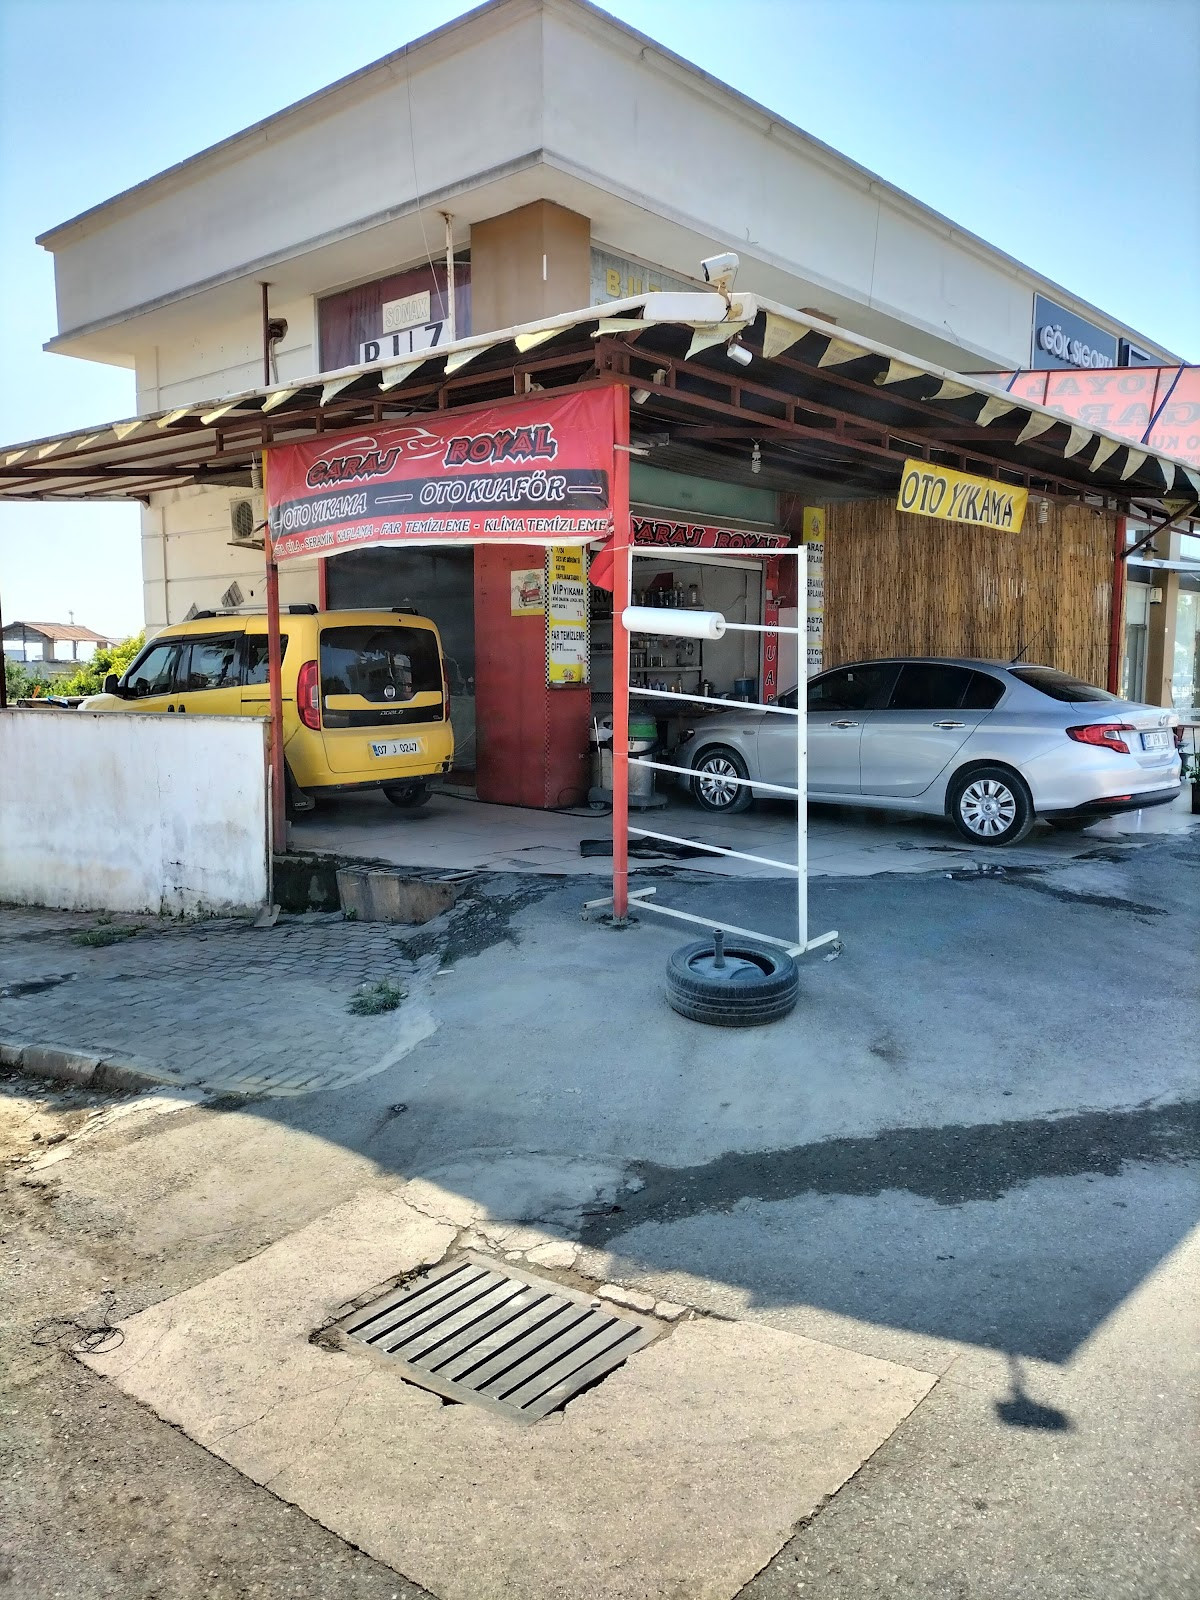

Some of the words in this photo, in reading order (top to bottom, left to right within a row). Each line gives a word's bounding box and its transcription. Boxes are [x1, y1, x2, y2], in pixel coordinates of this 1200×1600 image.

[385, 297, 428, 328] SONAX
[1041, 324, 1071, 359] GÖK
[442, 423, 558, 468] ROYAL
[283, 503, 312, 530] OTO
[311, 492, 368, 524] YIKAMA
[420, 480, 466, 505] OTO
[466, 470, 566, 503] KUAFÖR
[901, 471, 947, 514] OTO
[946, 482, 1014, 528] YIKAMA
[304, 530, 335, 550] SERAMİK
[336, 523, 374, 543] KAPLAMA
[380, 521, 402, 535] FAR
[405, 517, 470, 534] TEMİZLEME
[484, 515, 525, 533] KLİMA
[527, 515, 608, 533] TEMİZLEME
[634, 518, 706, 547] ARAJ
[807, 577, 824, 588] ERAMİK
[807, 588, 824, 598] APLAMA
[807, 616, 823, 625] ASTA
[378, 745, 387, 755] 07
[400, 742, 417, 753] 0247
